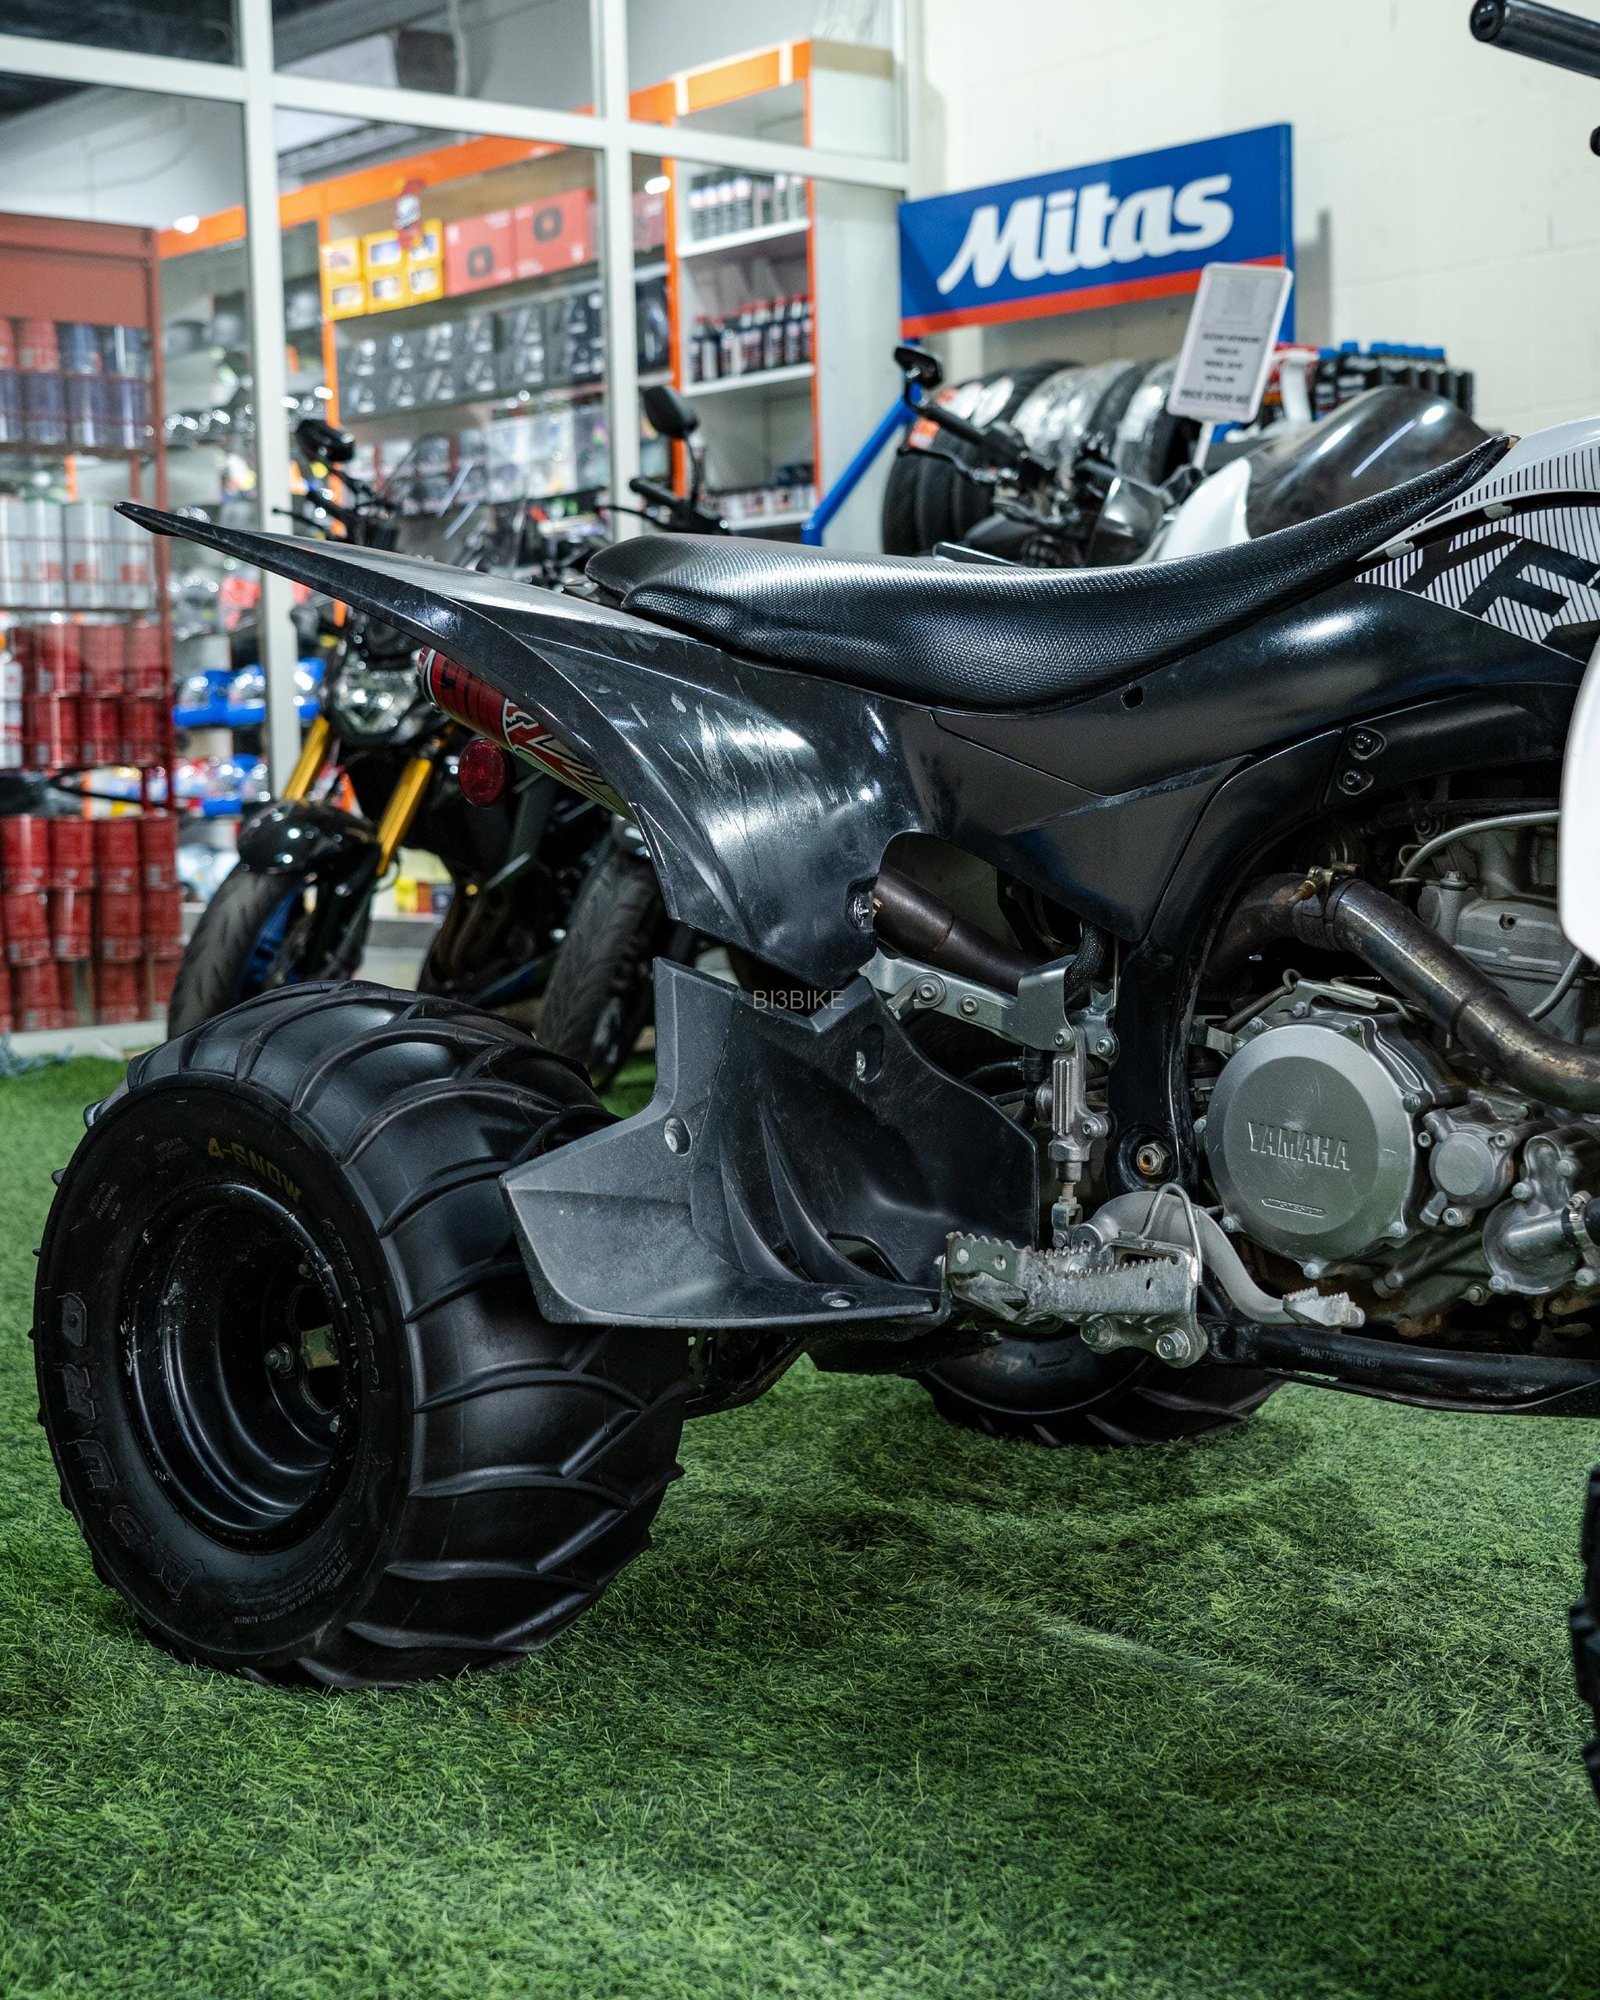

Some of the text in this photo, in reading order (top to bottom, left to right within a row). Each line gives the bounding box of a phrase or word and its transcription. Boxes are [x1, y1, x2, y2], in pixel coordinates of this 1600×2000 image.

[936, 174, 1234, 295] Mitas
[208, 1136, 302, 1206] 4-SNOW
[1248, 1121, 1350, 1171] YAMAHA
